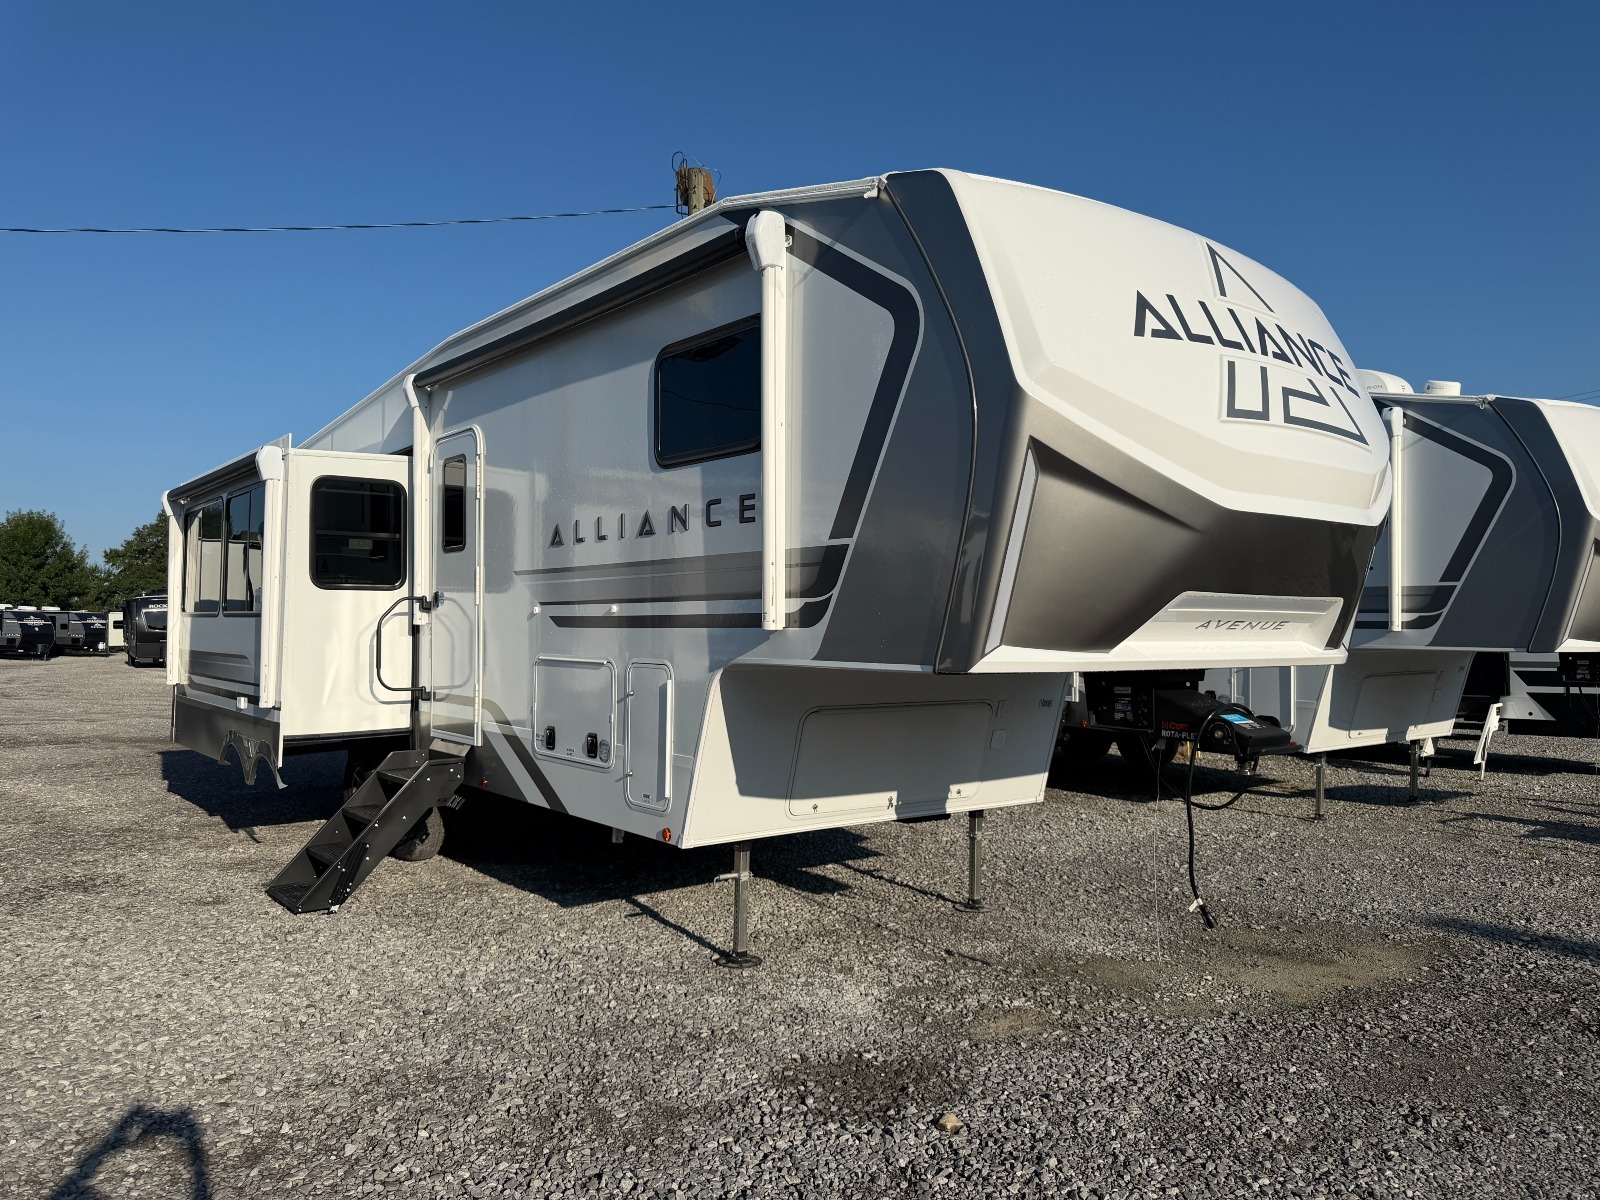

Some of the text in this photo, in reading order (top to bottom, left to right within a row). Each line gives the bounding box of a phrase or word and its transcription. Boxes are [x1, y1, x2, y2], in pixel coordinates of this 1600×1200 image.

[1134, 290, 1361, 399] ALLIANCE
[550, 493, 756, 548] ALLIANCE
[1195, 619, 1290, 630] AVENUE
